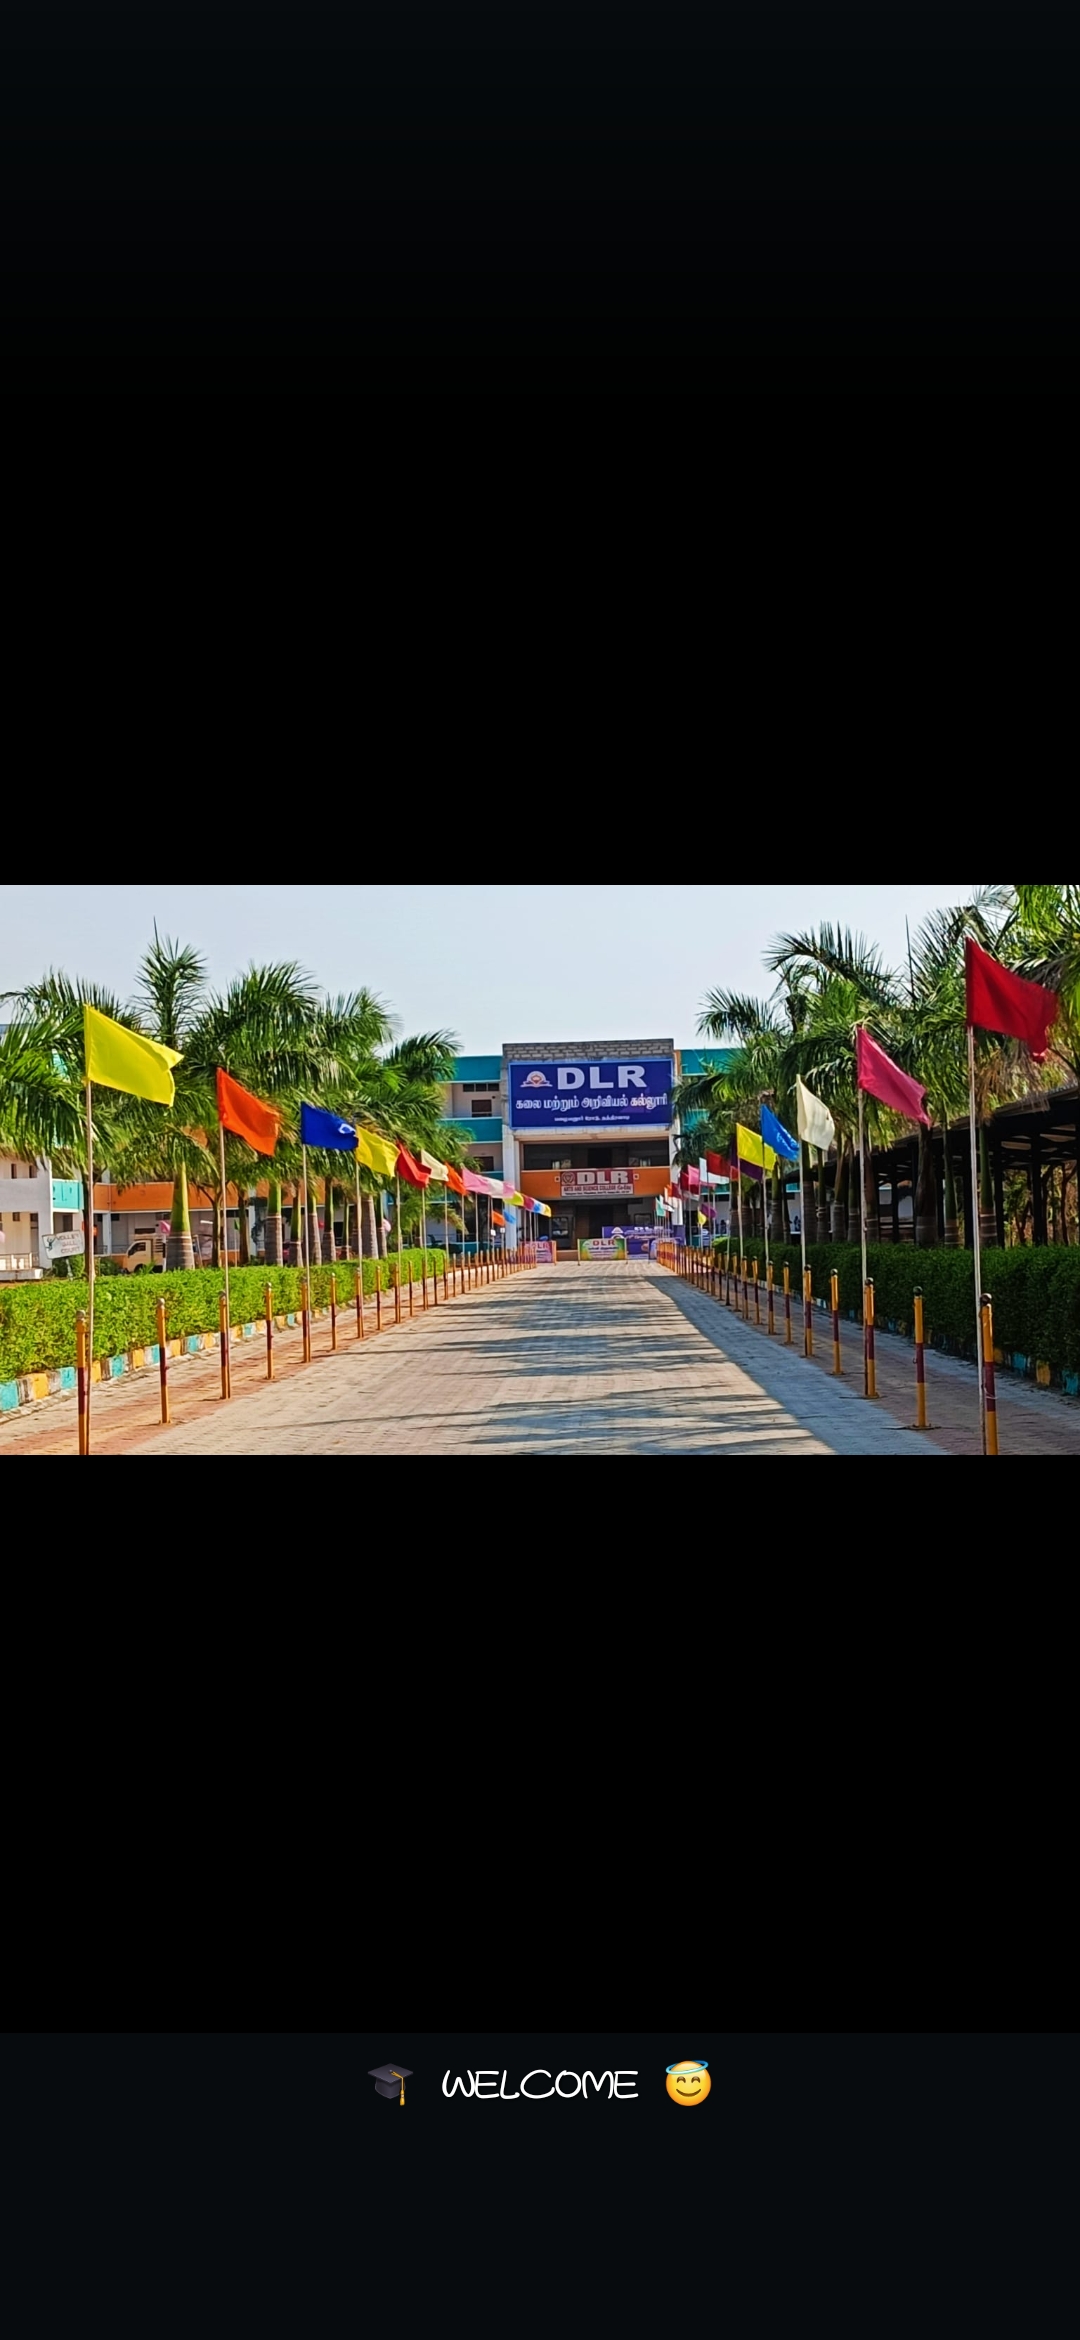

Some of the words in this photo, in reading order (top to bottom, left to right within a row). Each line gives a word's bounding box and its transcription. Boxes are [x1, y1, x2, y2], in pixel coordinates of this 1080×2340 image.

[557, 1065, 647, 1090] DLR
[515, 1099, 542, 1110] கலை
[543, 1095, 580, 1112] மற்றும்
[581, 1093, 629, 1111] அறிவியல்
[630, 1093, 668, 1110] கல்லூரி
[576, 1170, 629, 1185] DLR
